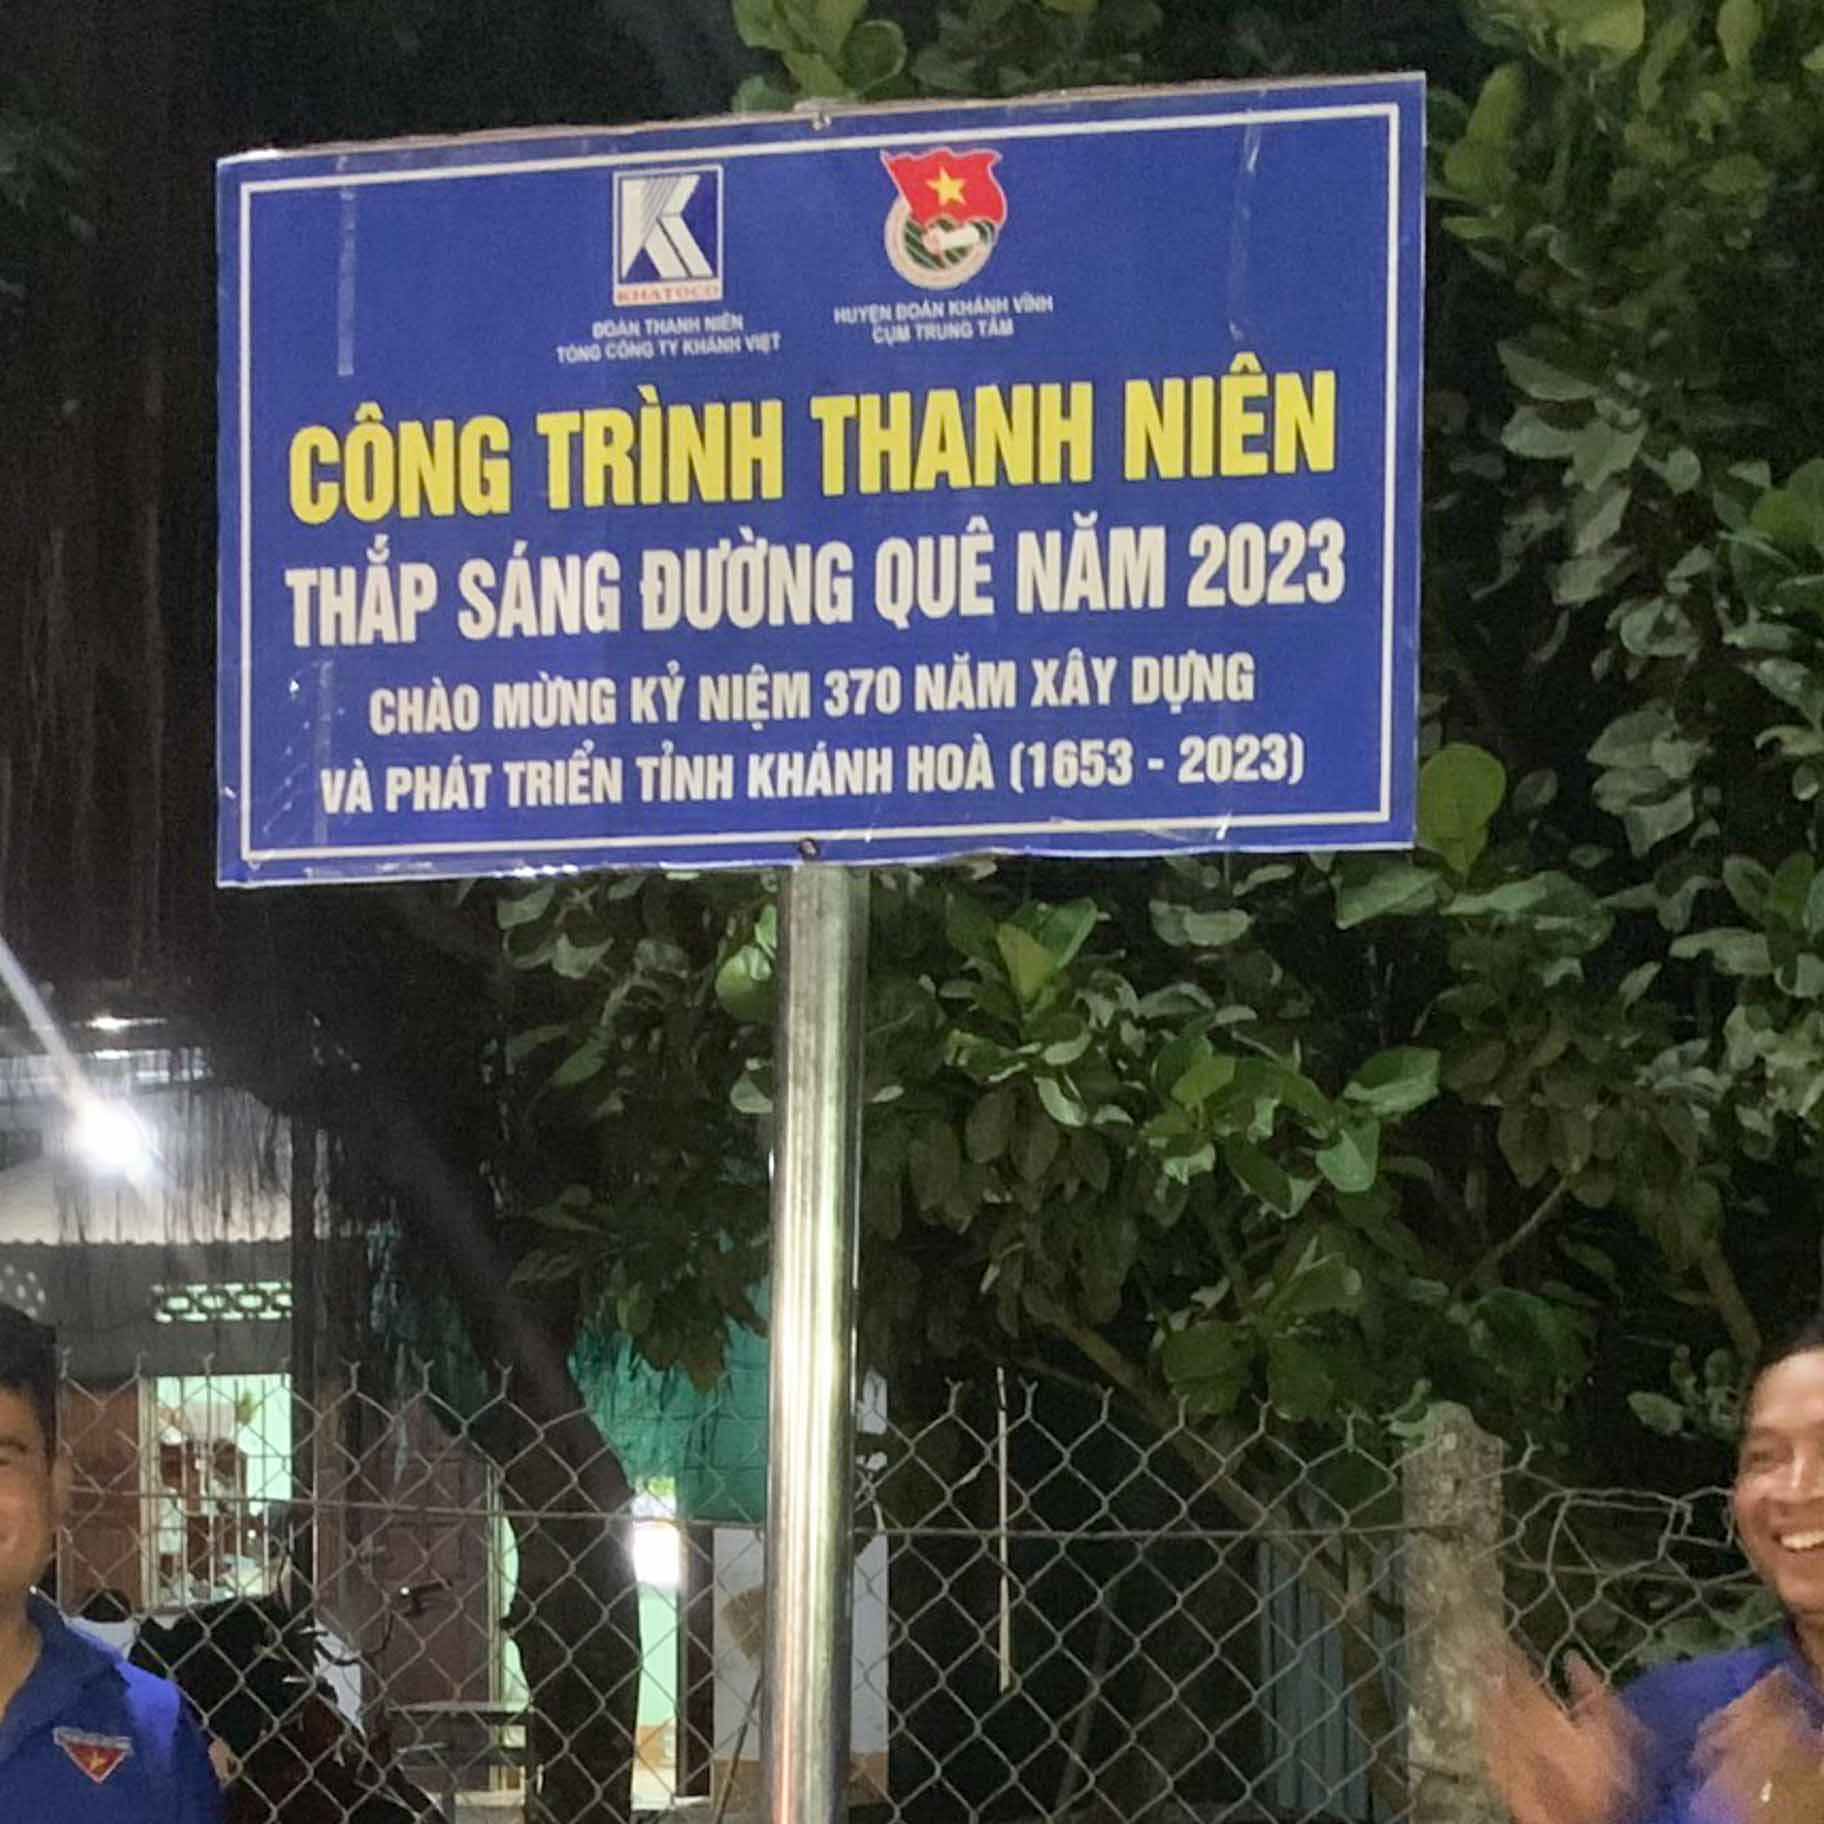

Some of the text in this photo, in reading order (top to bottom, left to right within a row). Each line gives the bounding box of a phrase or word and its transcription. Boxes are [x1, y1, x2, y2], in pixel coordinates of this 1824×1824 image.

[645, 314, 700, 335] THANH
[705, 309, 743, 333] NIÊN
[872, 317, 1014, 346] CỤM TRUNG TÂM
[949, 294, 1009, 316] KHÁNH
[605, 338, 655, 361] CÔNG
[660, 339, 678, 357] TY
[683, 331, 741, 355] KHÁNH
[746, 331, 780, 356] VIỆT
[289, 352, 1336, 524] CÔNG TRÌNH THANH NIÊN
[285, 510, 1346, 648] THẮP SÁNG ĐƯỜNG QUÊ NĂM 2023
[369, 647, 1256, 735] CHÀO MỪNG KỶ NIỆM 370 NĂM XÂY DỰNG
[320, 758, 373, 814] VÀ
[386, 754, 491, 812] PHÁT
[503, 738, 622, 807] TRIỂN
[635, 739, 734, 802] TỈNH
[747, 734, 893, 799] KHÁNH
[907, 732, 995, 793] HOÀ
[1010, 737, 1134, 793] (1653
[1177, 731, 1304, 786] 2023)
